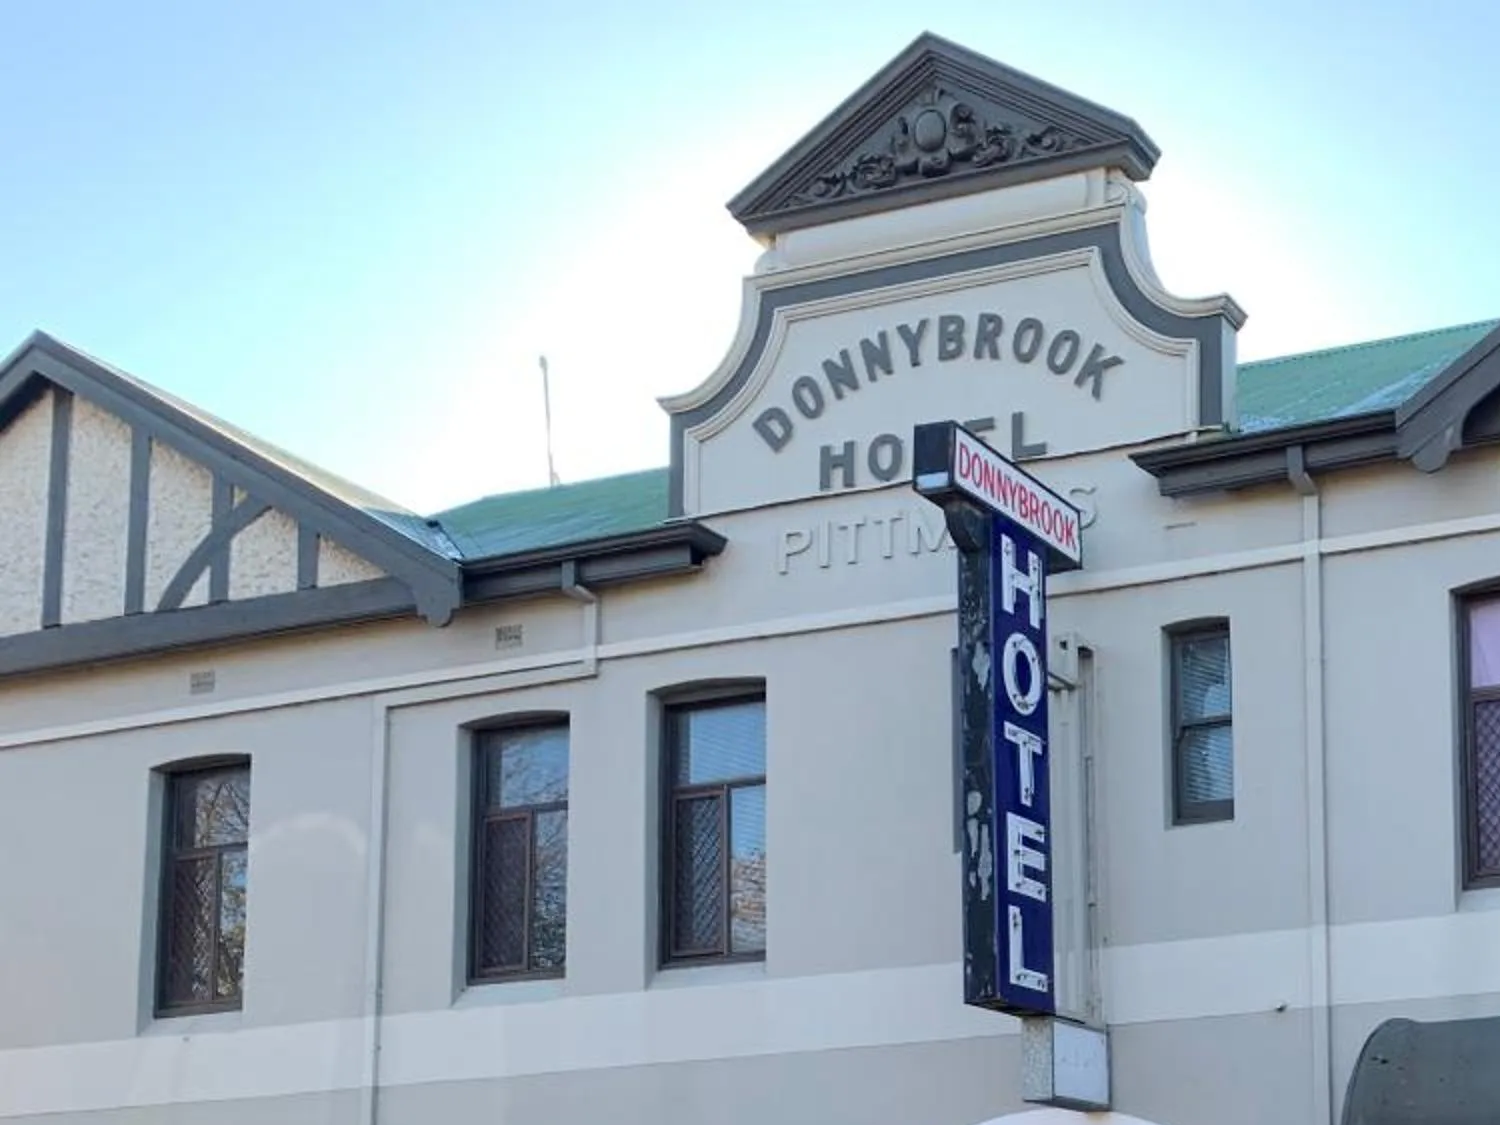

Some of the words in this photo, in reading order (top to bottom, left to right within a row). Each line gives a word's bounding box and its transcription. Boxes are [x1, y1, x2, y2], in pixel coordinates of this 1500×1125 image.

[751, 312, 1124, 453] DONNYBROOK
[819, 411, 1048, 491] HOL
[958, 442, 1077, 550] DONNYBROOK
[1001, 532, 1048, 993] HOTEL
